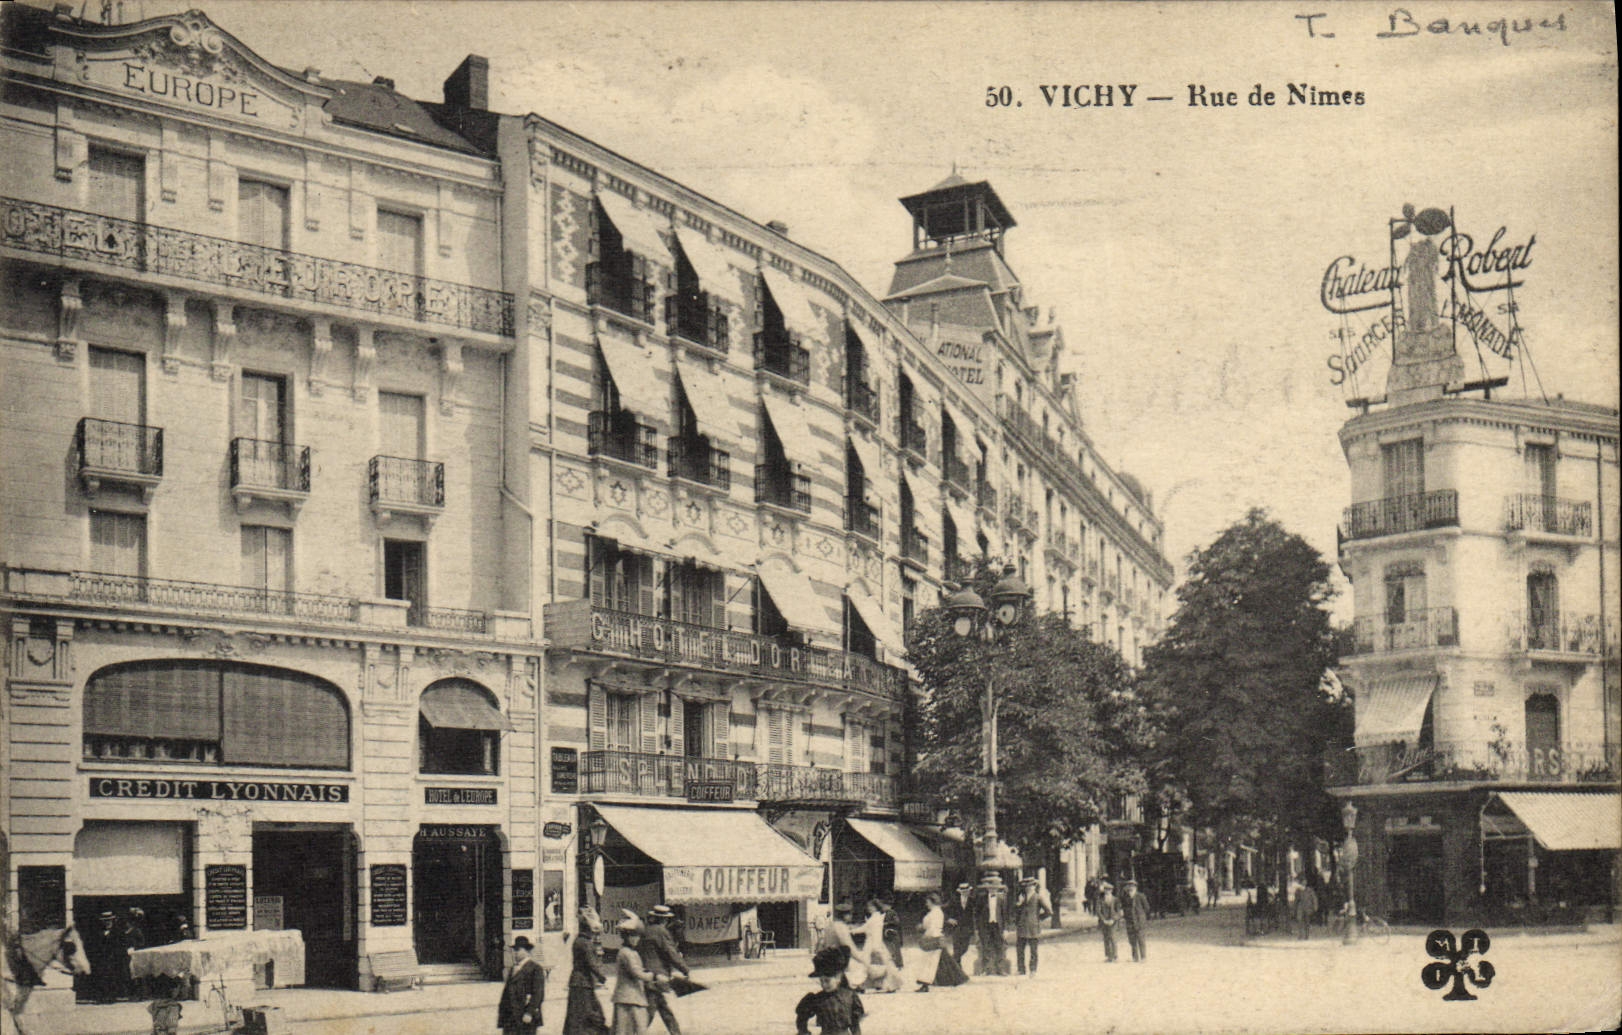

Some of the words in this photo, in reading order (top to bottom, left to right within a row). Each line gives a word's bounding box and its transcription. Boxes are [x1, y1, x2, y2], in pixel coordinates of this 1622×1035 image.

[122, 62, 258, 117] EUROPE
[1439, 226, 1537, 292] Robert
[619, 757, 748, 792] SPLENDID
[98, 778, 198, 799] CREDIT
[210, 780, 343, 802] LYONNAIS
[428, 789, 451, 803] HOTEL
[689, 785, 731, 800] COIFFEUR
[702, 867, 790, 896] COIFFEUR
[688, 916, 731, 931] DAMES
